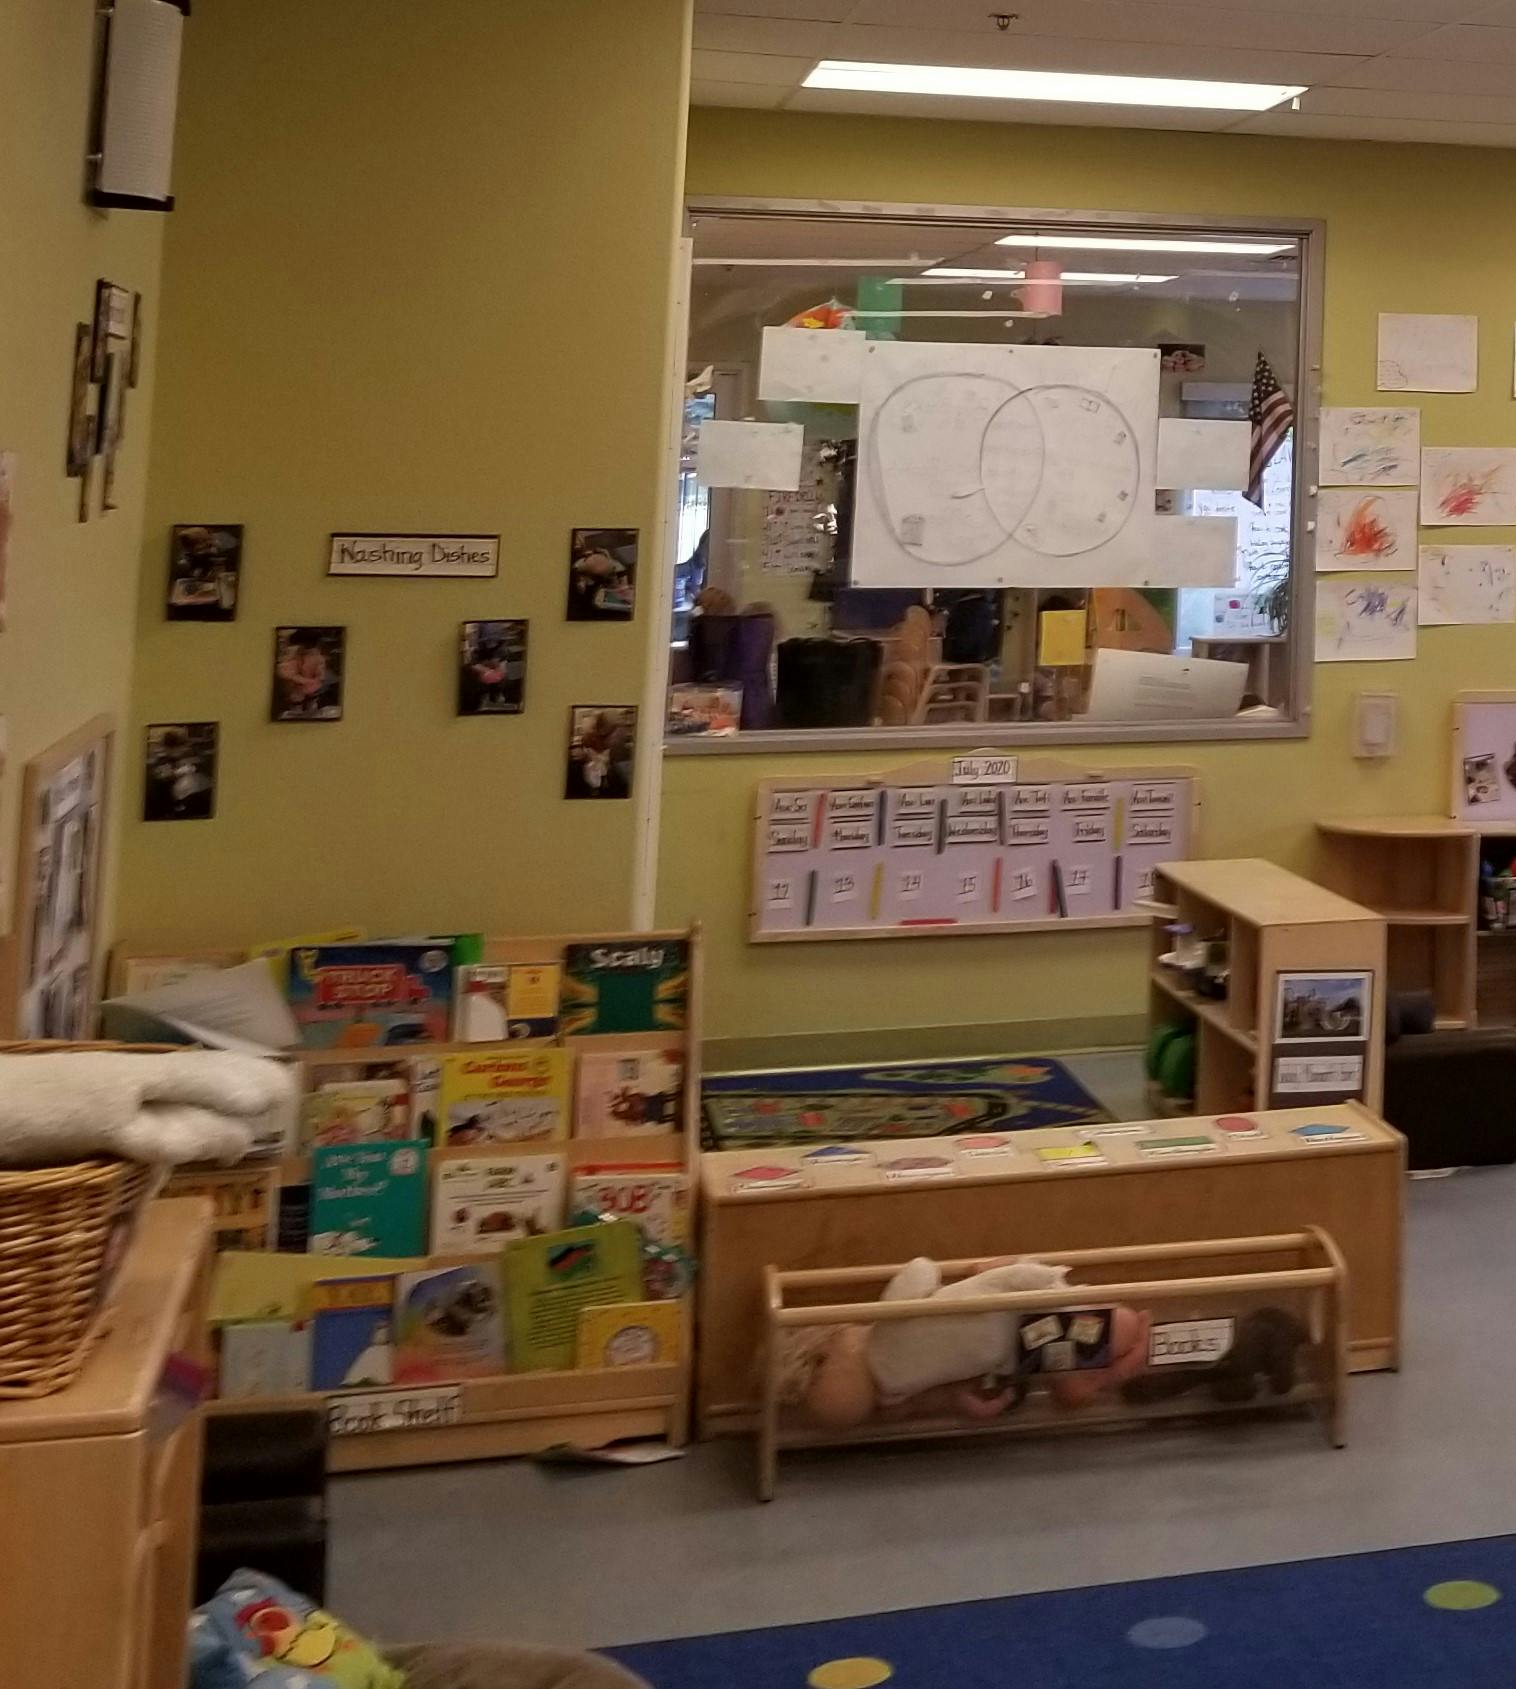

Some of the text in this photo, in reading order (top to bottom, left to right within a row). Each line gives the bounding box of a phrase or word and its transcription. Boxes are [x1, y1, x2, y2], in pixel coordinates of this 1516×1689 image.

[339, 539, 491, 571] Washing Dishes
[954, 760, 1011, 780] July 2020
[590, 947, 664, 969] Scaly
[1151, 1329, 1220, 1358] Books
[328, 1401, 387, 1433] Book
